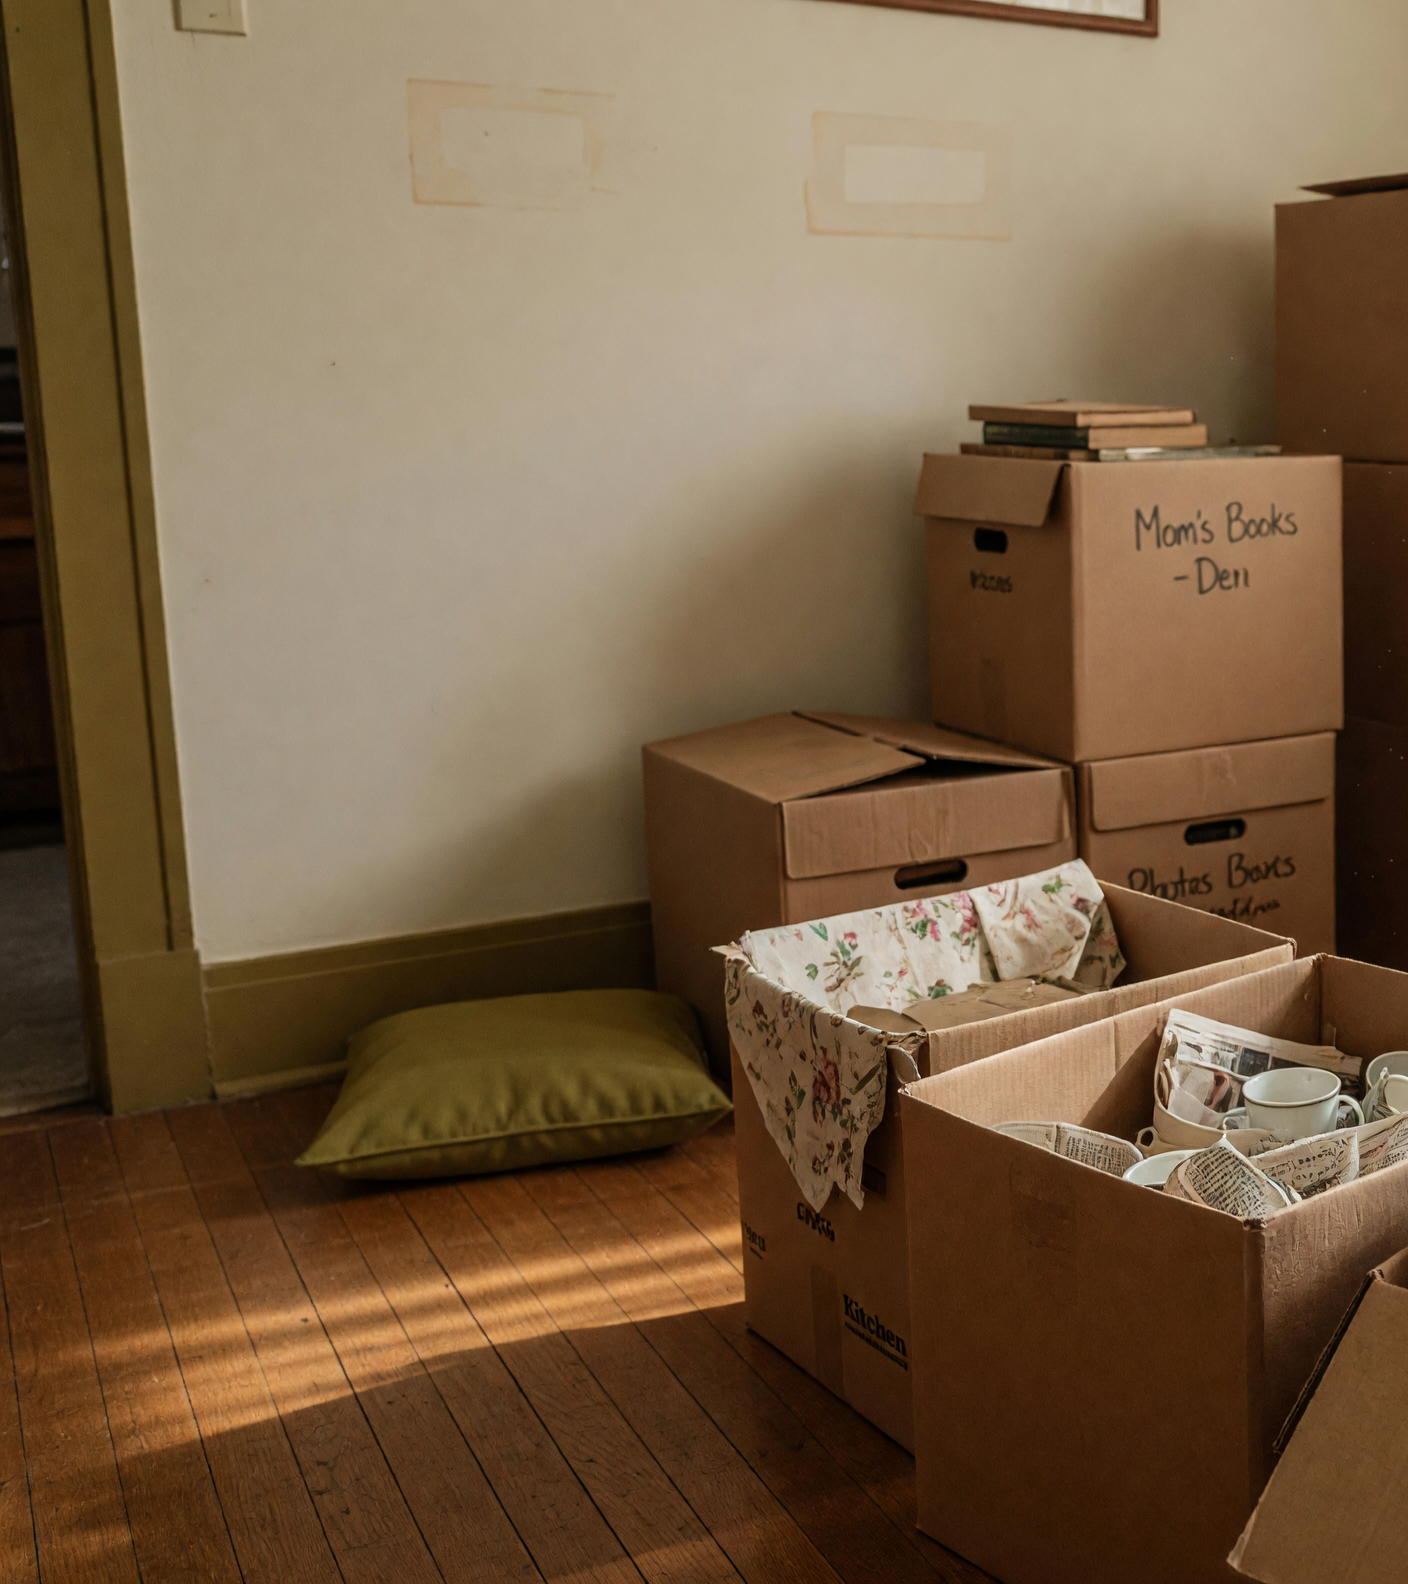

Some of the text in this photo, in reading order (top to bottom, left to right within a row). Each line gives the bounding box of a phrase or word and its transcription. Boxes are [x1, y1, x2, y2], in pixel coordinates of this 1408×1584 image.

[1134, 501, 1298, 551] Mom's Books
[843, 1293, 908, 1358] Kitchen
